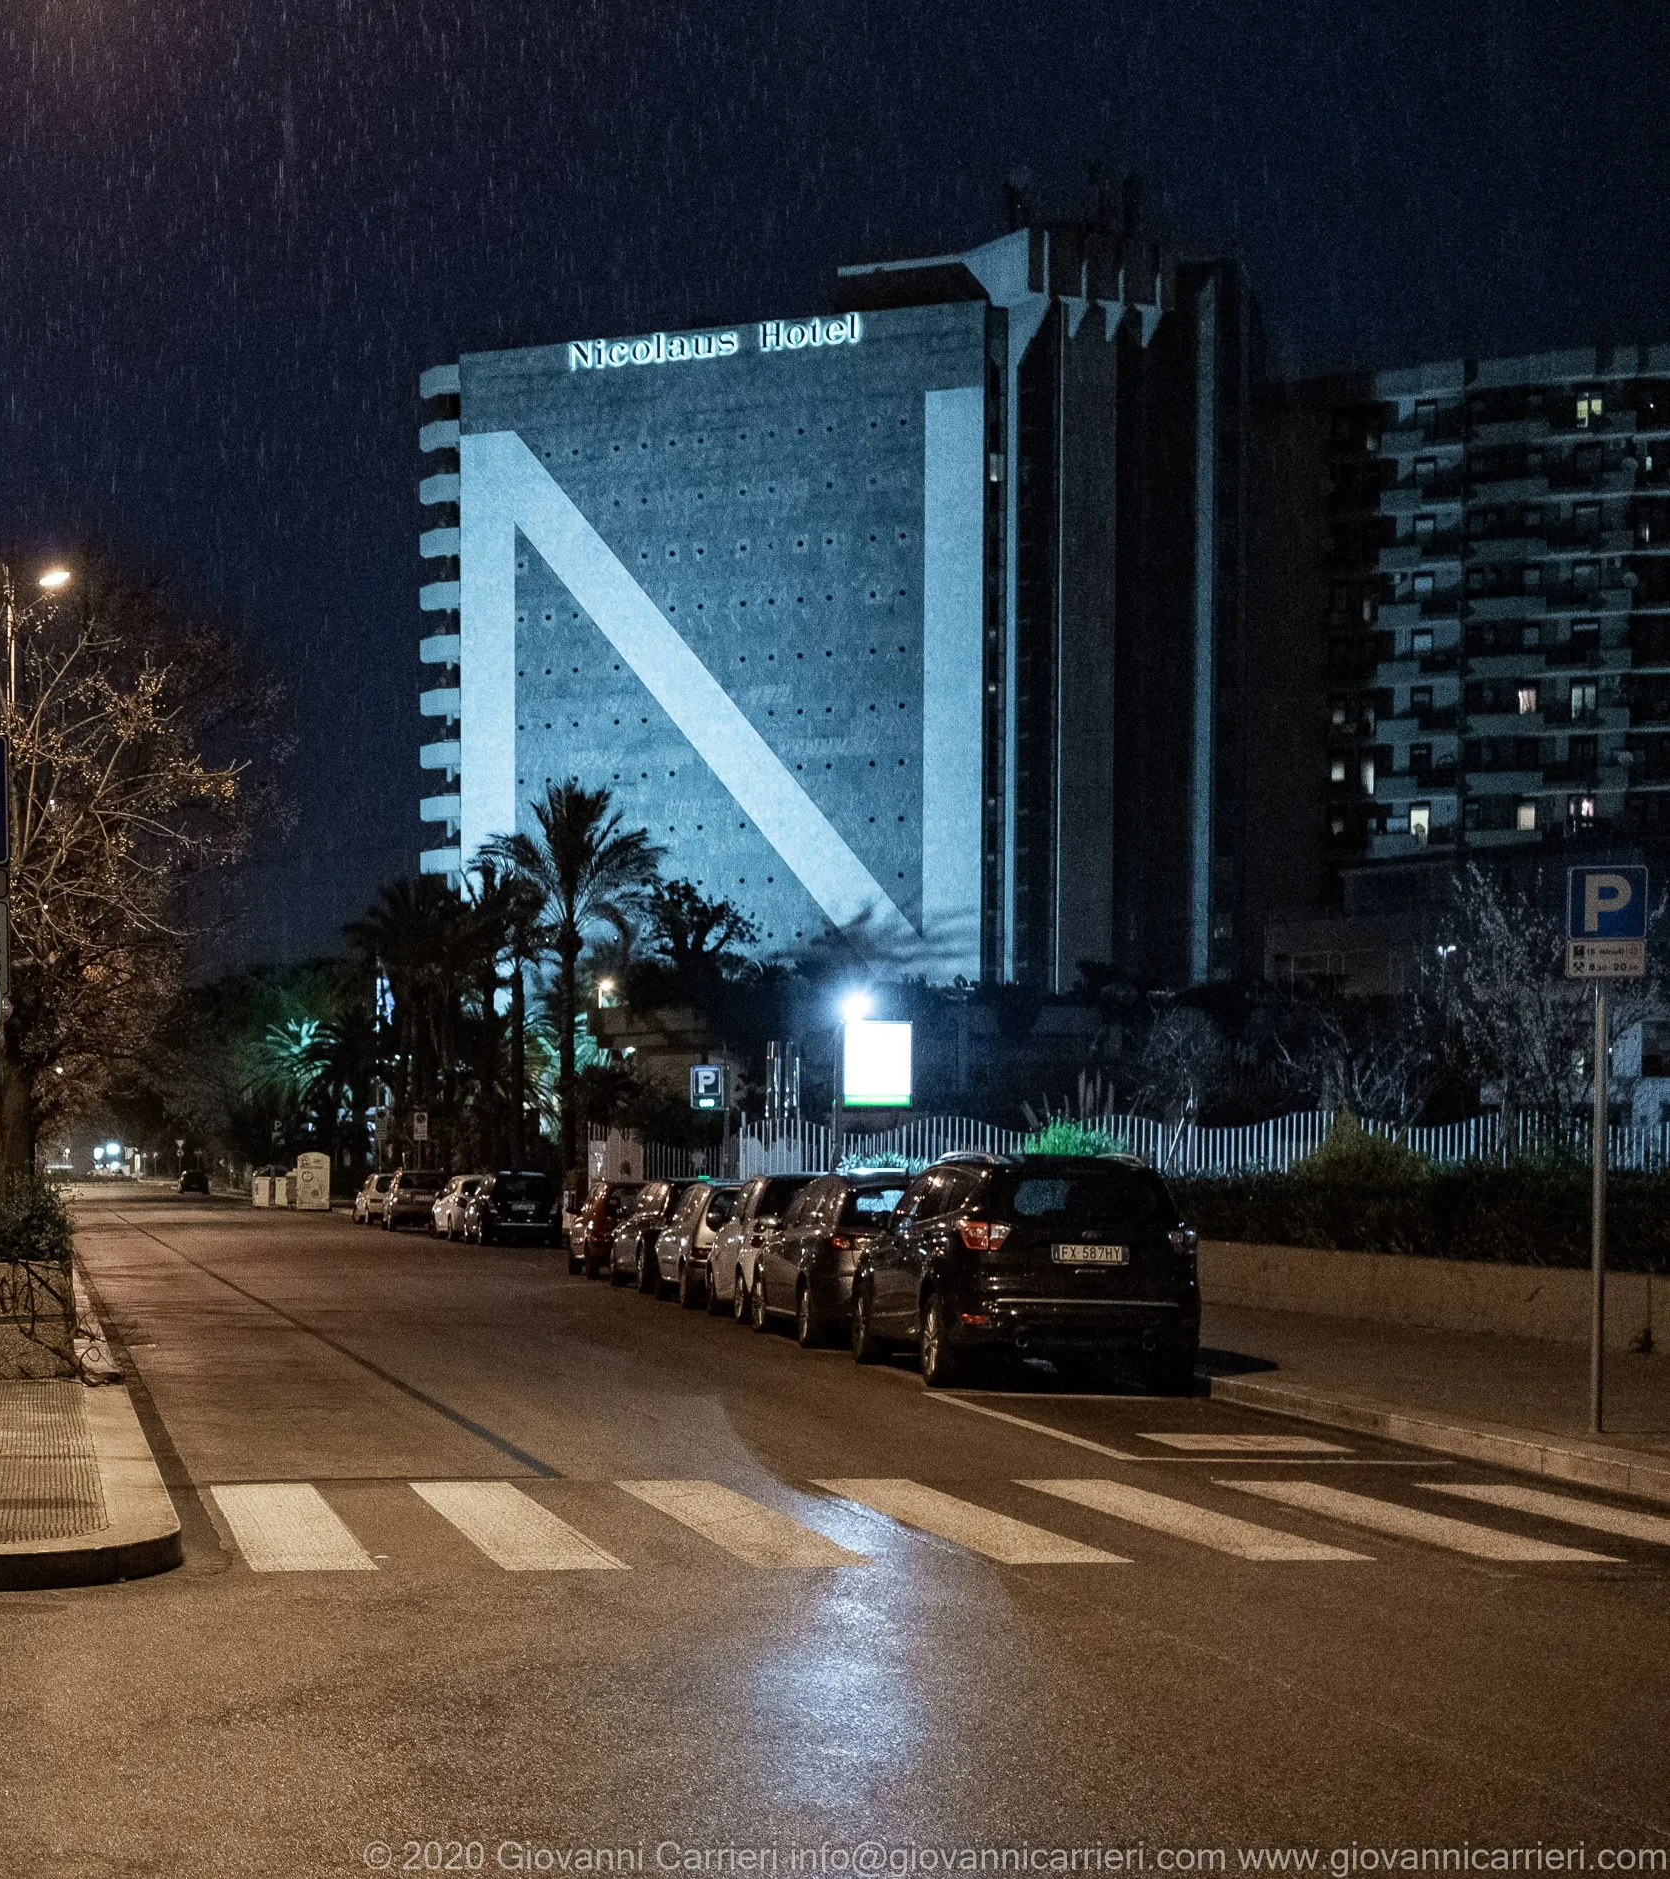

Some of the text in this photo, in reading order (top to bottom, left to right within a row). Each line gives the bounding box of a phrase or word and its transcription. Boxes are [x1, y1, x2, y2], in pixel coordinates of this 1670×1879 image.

[568, 311, 862, 371] Nicolaus Hotel
[1584, 874, 1632, 932] P
[698, 1071, 716, 1093] P
[1062, 1246, 1076, 1259] FX
